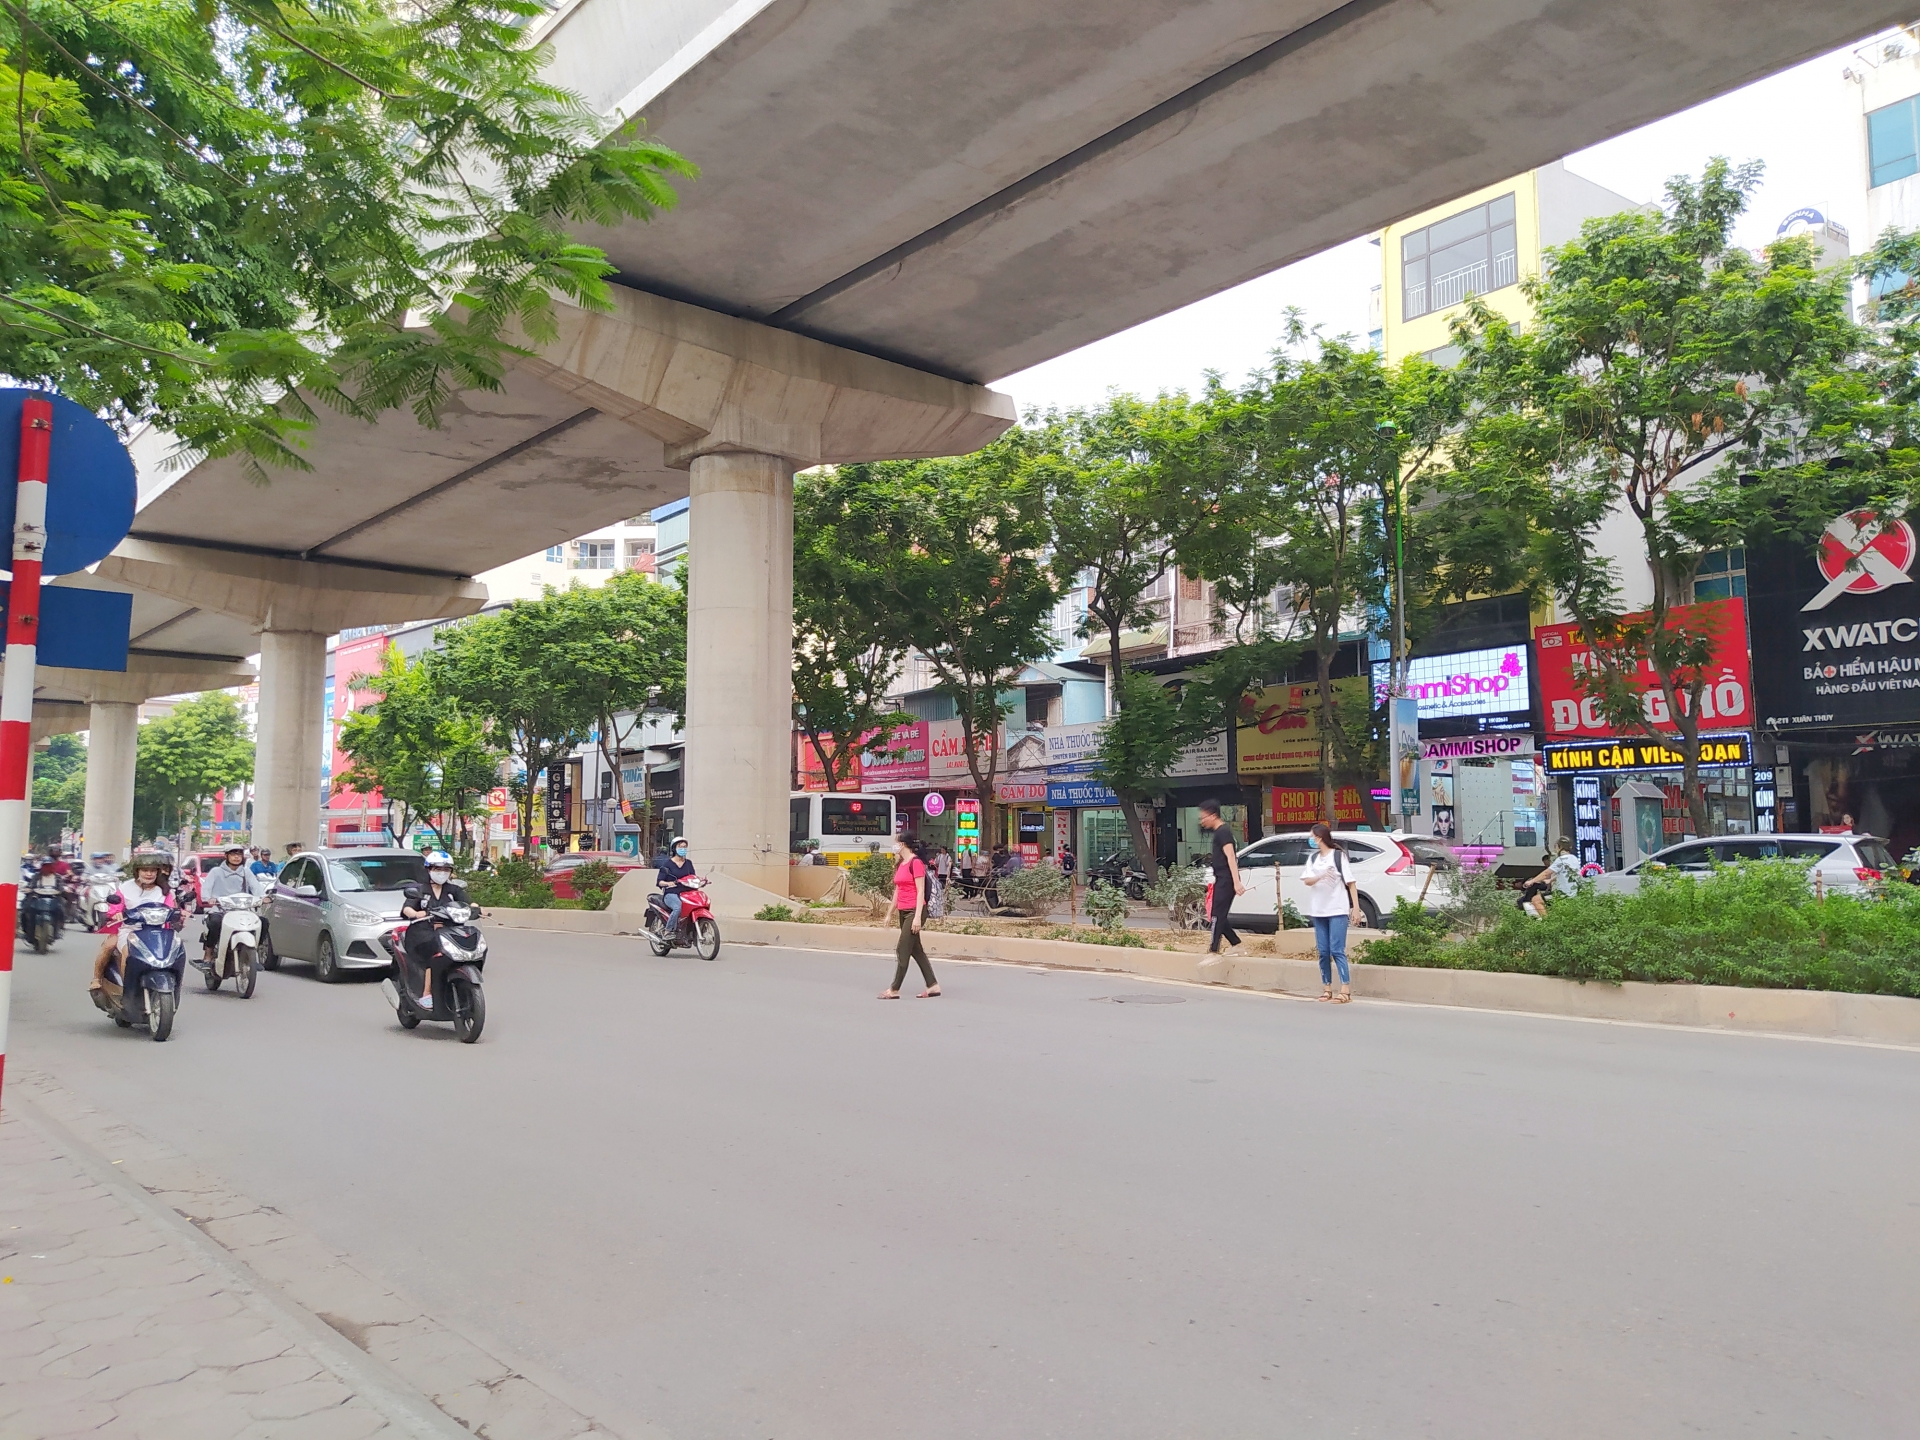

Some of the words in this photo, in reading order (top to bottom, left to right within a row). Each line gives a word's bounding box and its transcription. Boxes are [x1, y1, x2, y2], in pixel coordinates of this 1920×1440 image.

[1802, 617, 1920, 652] XWATC
[1878, 656, 1912, 676] HẬU
[1815, 681, 1850, 695] HÀNG
[1851, 678, 1876, 693] ĐẦU
[911, 727, 919, 738] BÉ
[1048, 733, 1065, 750] NHÀ
[1065, 728, 1091, 749] THUỐC
[932, 729, 959, 758] CẦM
[1551, 744, 1593, 769] KÍNH
[1598, 745, 1635, 769] CẬN
[1754, 771, 1773, 781] 209
[1051, 785, 1067, 800] NHÀ
[1068, 783, 1093, 799] THUỐC
[1576, 781, 1597, 798] KÍNH
[1755, 786, 1775, 807] KÍNH
[1281, 791, 1305, 808] CHO
[1578, 800, 1598, 819] MẮT
[1022, 844, 1039, 855] MUA
